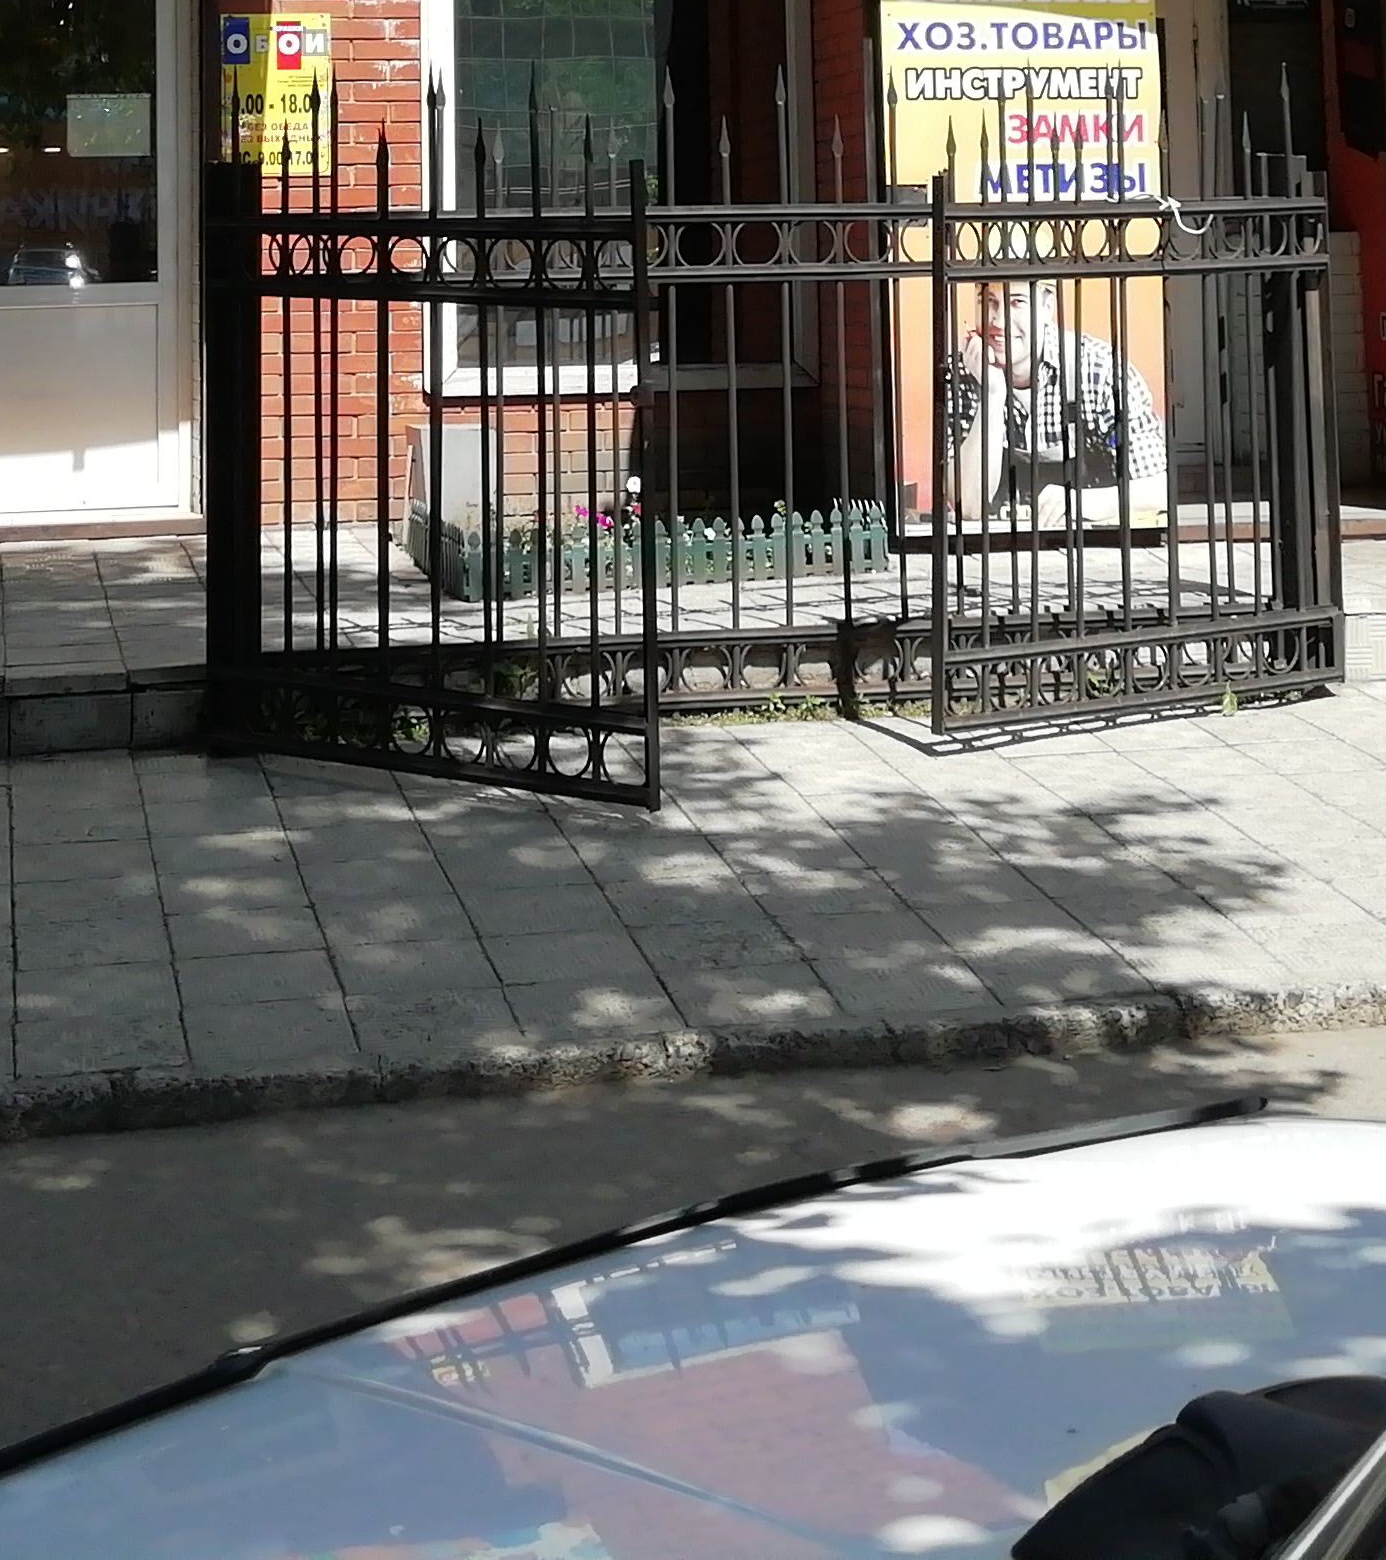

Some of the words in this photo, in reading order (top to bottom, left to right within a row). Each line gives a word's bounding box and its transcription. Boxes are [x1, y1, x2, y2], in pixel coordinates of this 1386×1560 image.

[226, 33, 324, 55] ОБОИ
[897, 22, 1147, 50] ХОЗ.ТОВАРЫ
[906, 67, 1142, 100] ИНСТРУМЕНТ
[231, 94, 264, 114] .00
[281, 94, 315, 114] 18.0
[256, 135, 322, 143] ВЫХДНЫХ
[1008, 114, 1144, 143] ЗАМКИ
